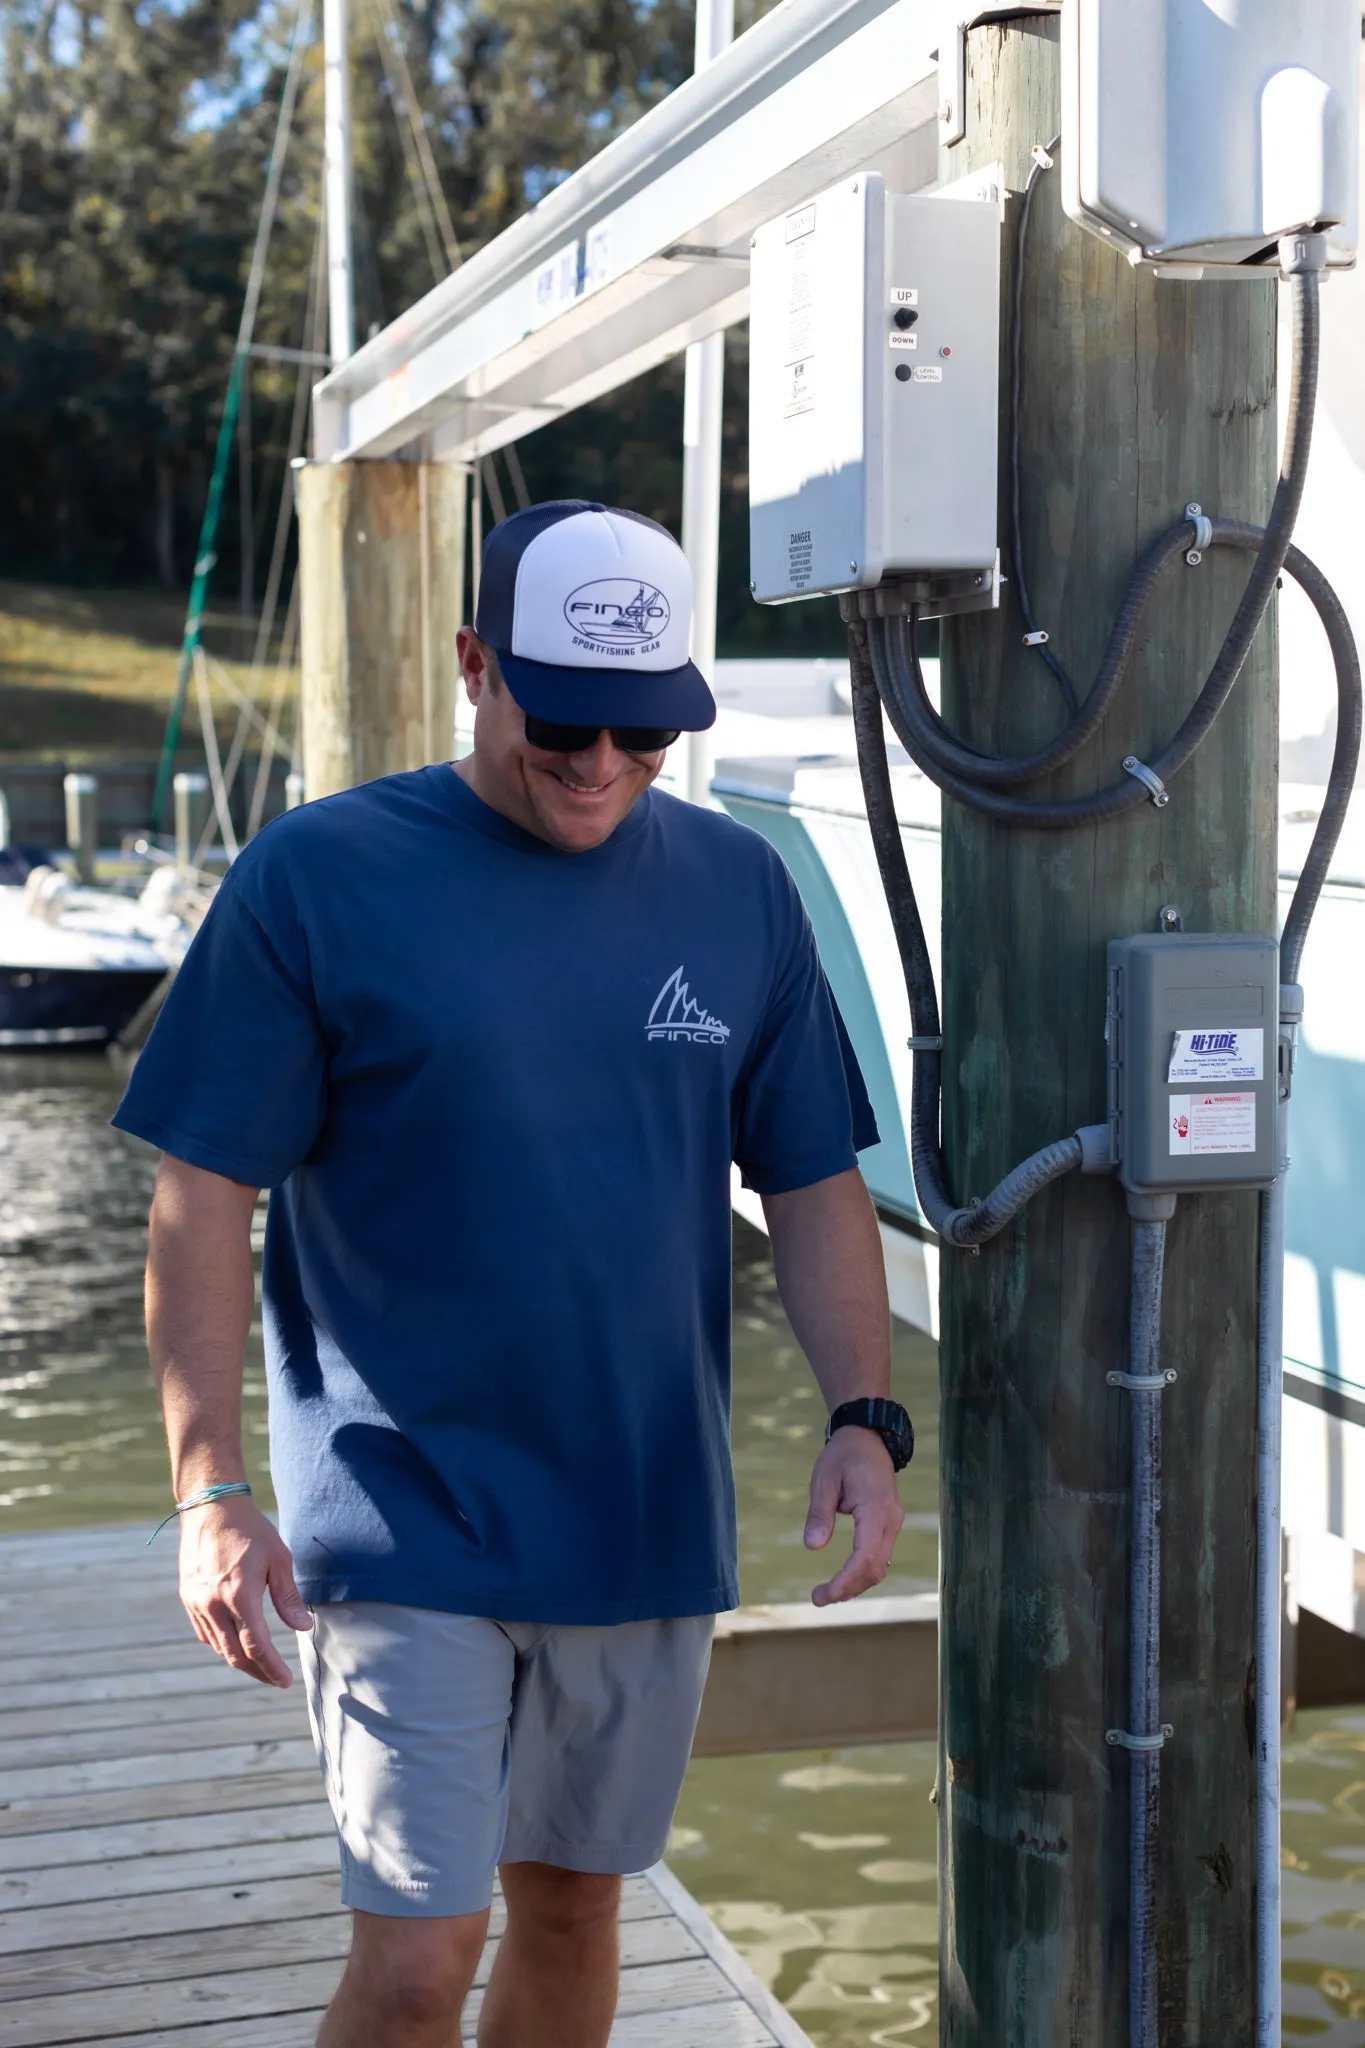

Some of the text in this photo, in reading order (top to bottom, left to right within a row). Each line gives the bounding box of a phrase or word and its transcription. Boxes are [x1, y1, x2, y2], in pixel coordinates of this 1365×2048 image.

[897, 291, 912, 301] UP
[892, 336, 914, 345] DOWN
[790, 531, 811, 544] DANGER
[572, 636, 661, 656] SPORTFISHING GEAR
